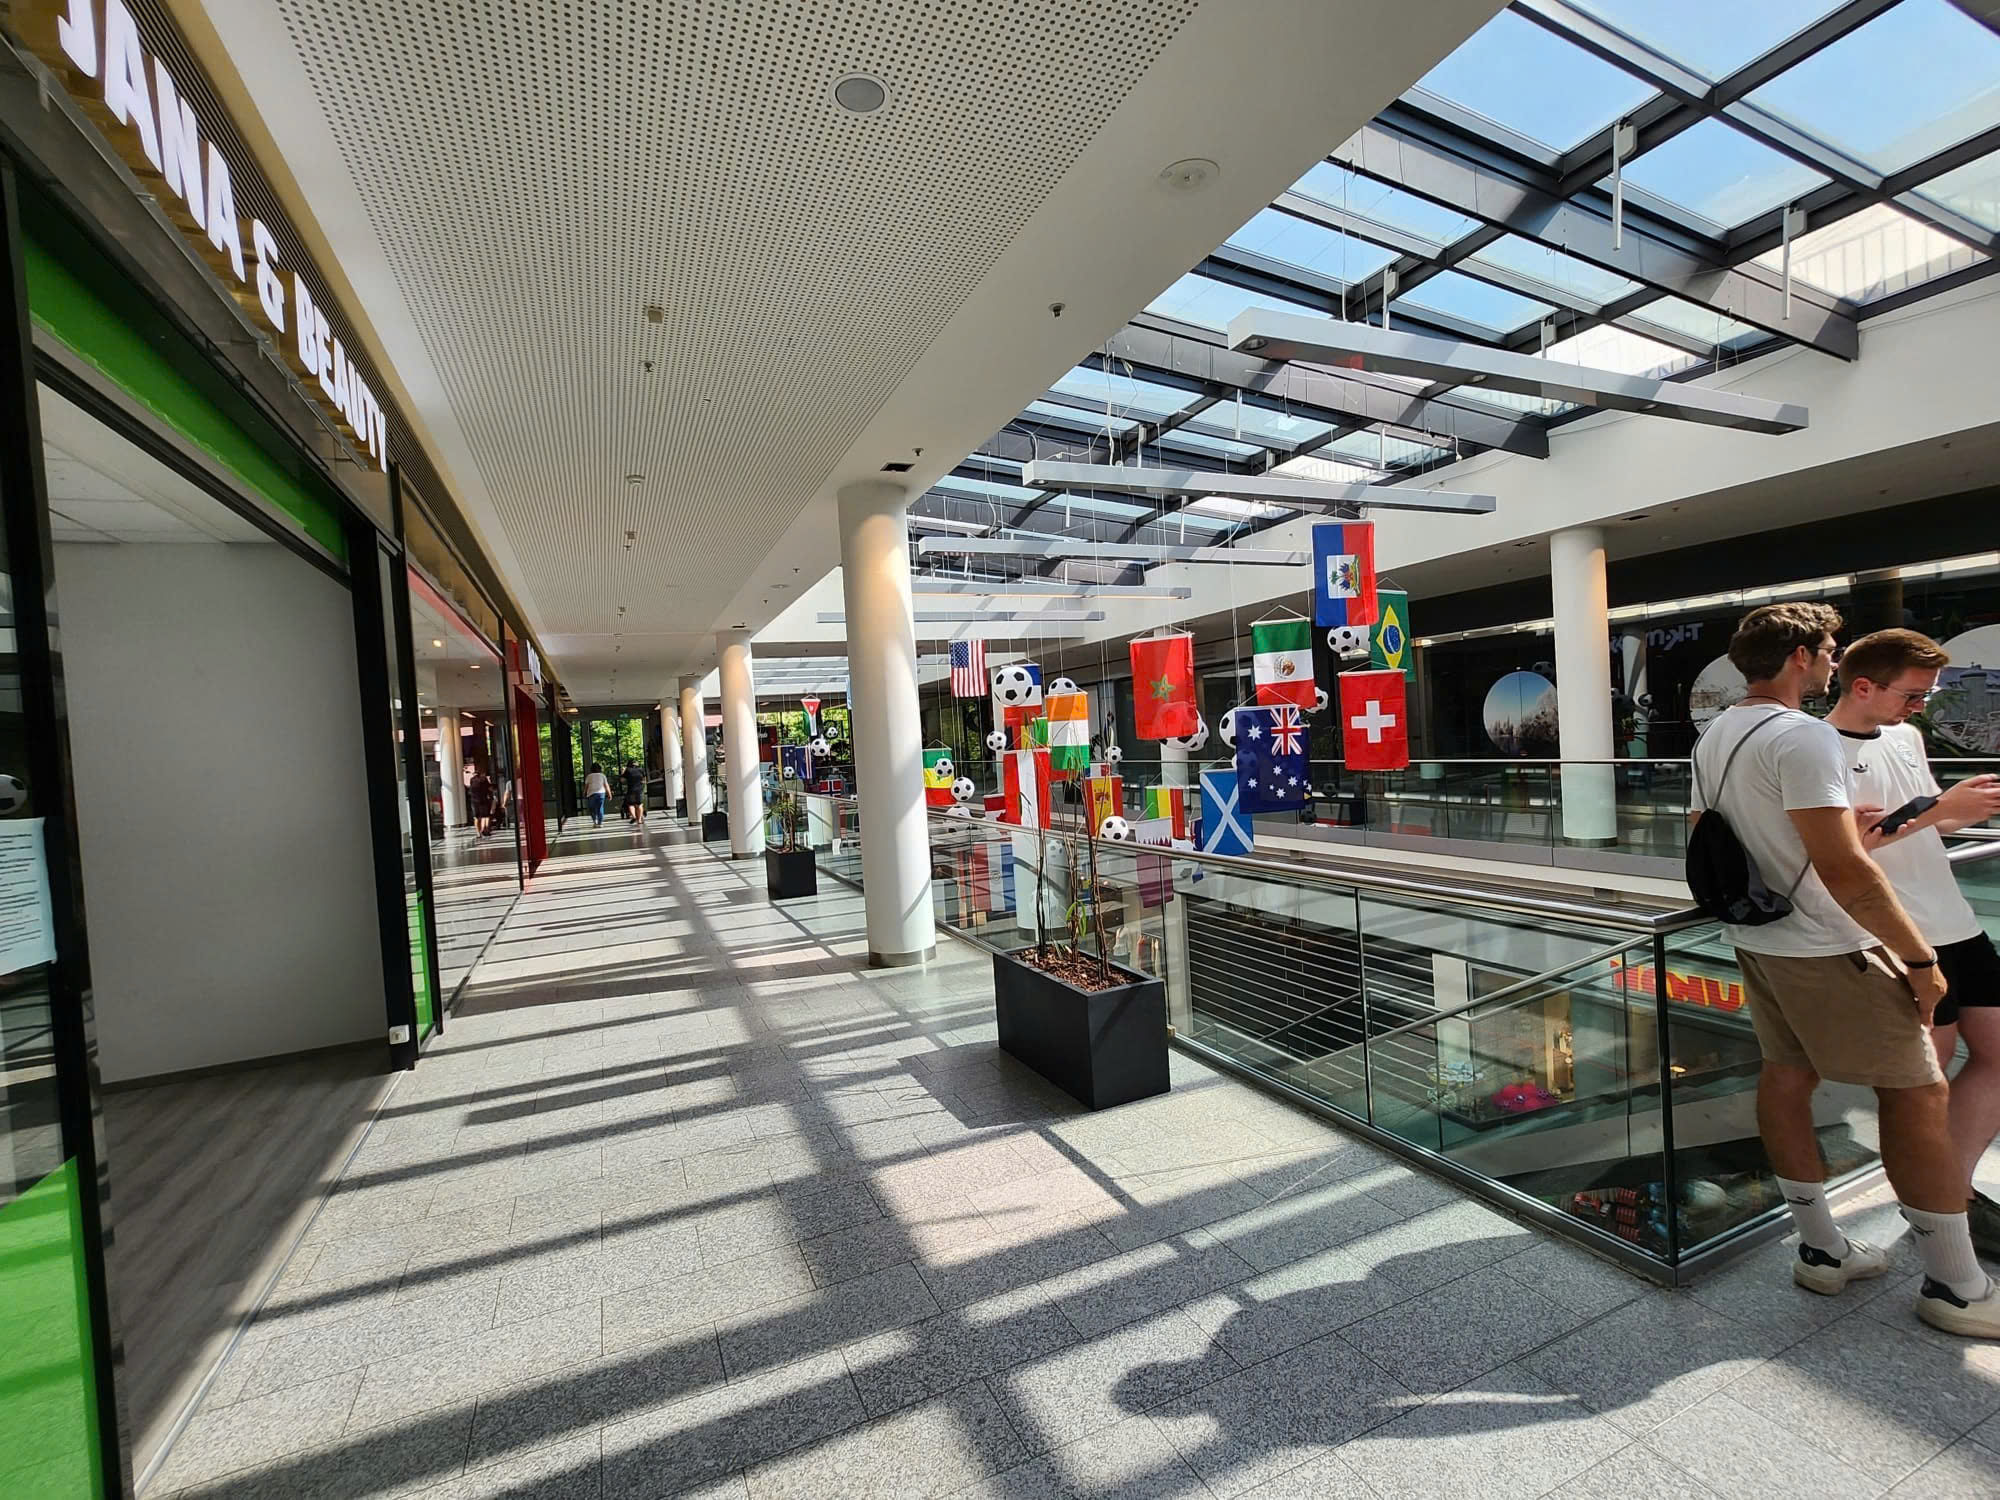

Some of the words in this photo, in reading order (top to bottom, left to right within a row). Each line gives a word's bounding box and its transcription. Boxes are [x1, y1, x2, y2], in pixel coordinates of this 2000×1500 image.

[57, 0, 246, 283] JANA
[252, 218, 285, 333] &
[294, 271, 387, 473] BEAUTY
